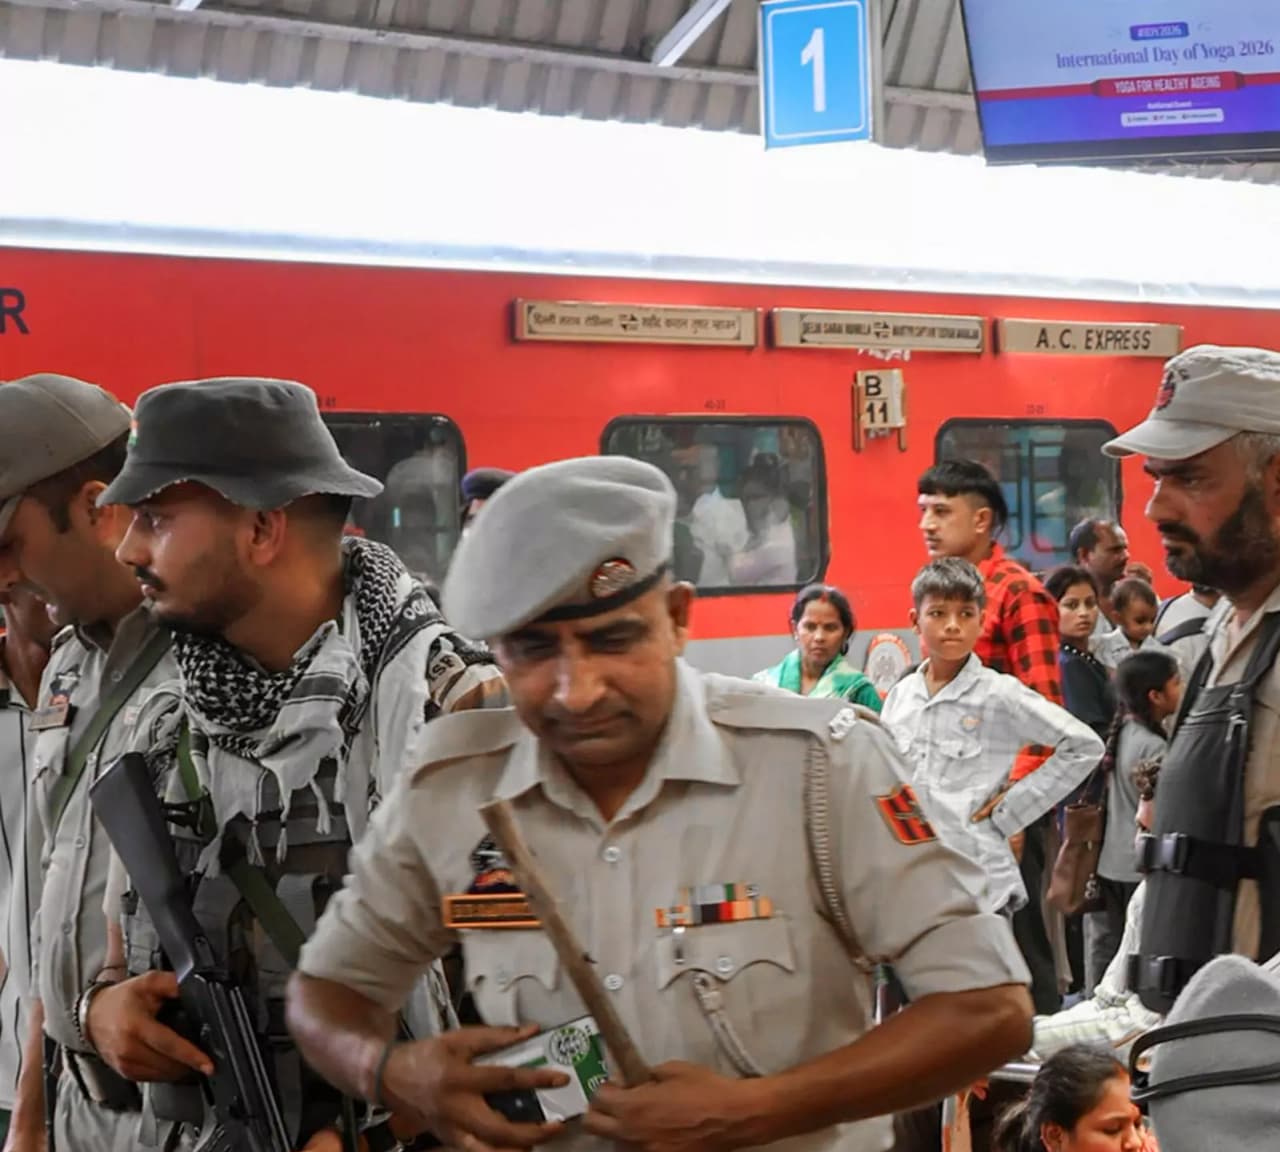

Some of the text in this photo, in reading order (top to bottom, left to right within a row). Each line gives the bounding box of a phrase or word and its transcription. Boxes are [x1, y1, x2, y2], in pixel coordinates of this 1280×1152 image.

[1056, 40, 1275, 69] International Day of Yoga 2026
[798, 24, 828, 114] 1
[1115, 75, 1222, 94] YOGA FOR HEALTHY AGEING
[1084, 329, 1151, 351] EXPRESS
[865, 375, 882, 396] B
[866, 402, 888, 423] 11
